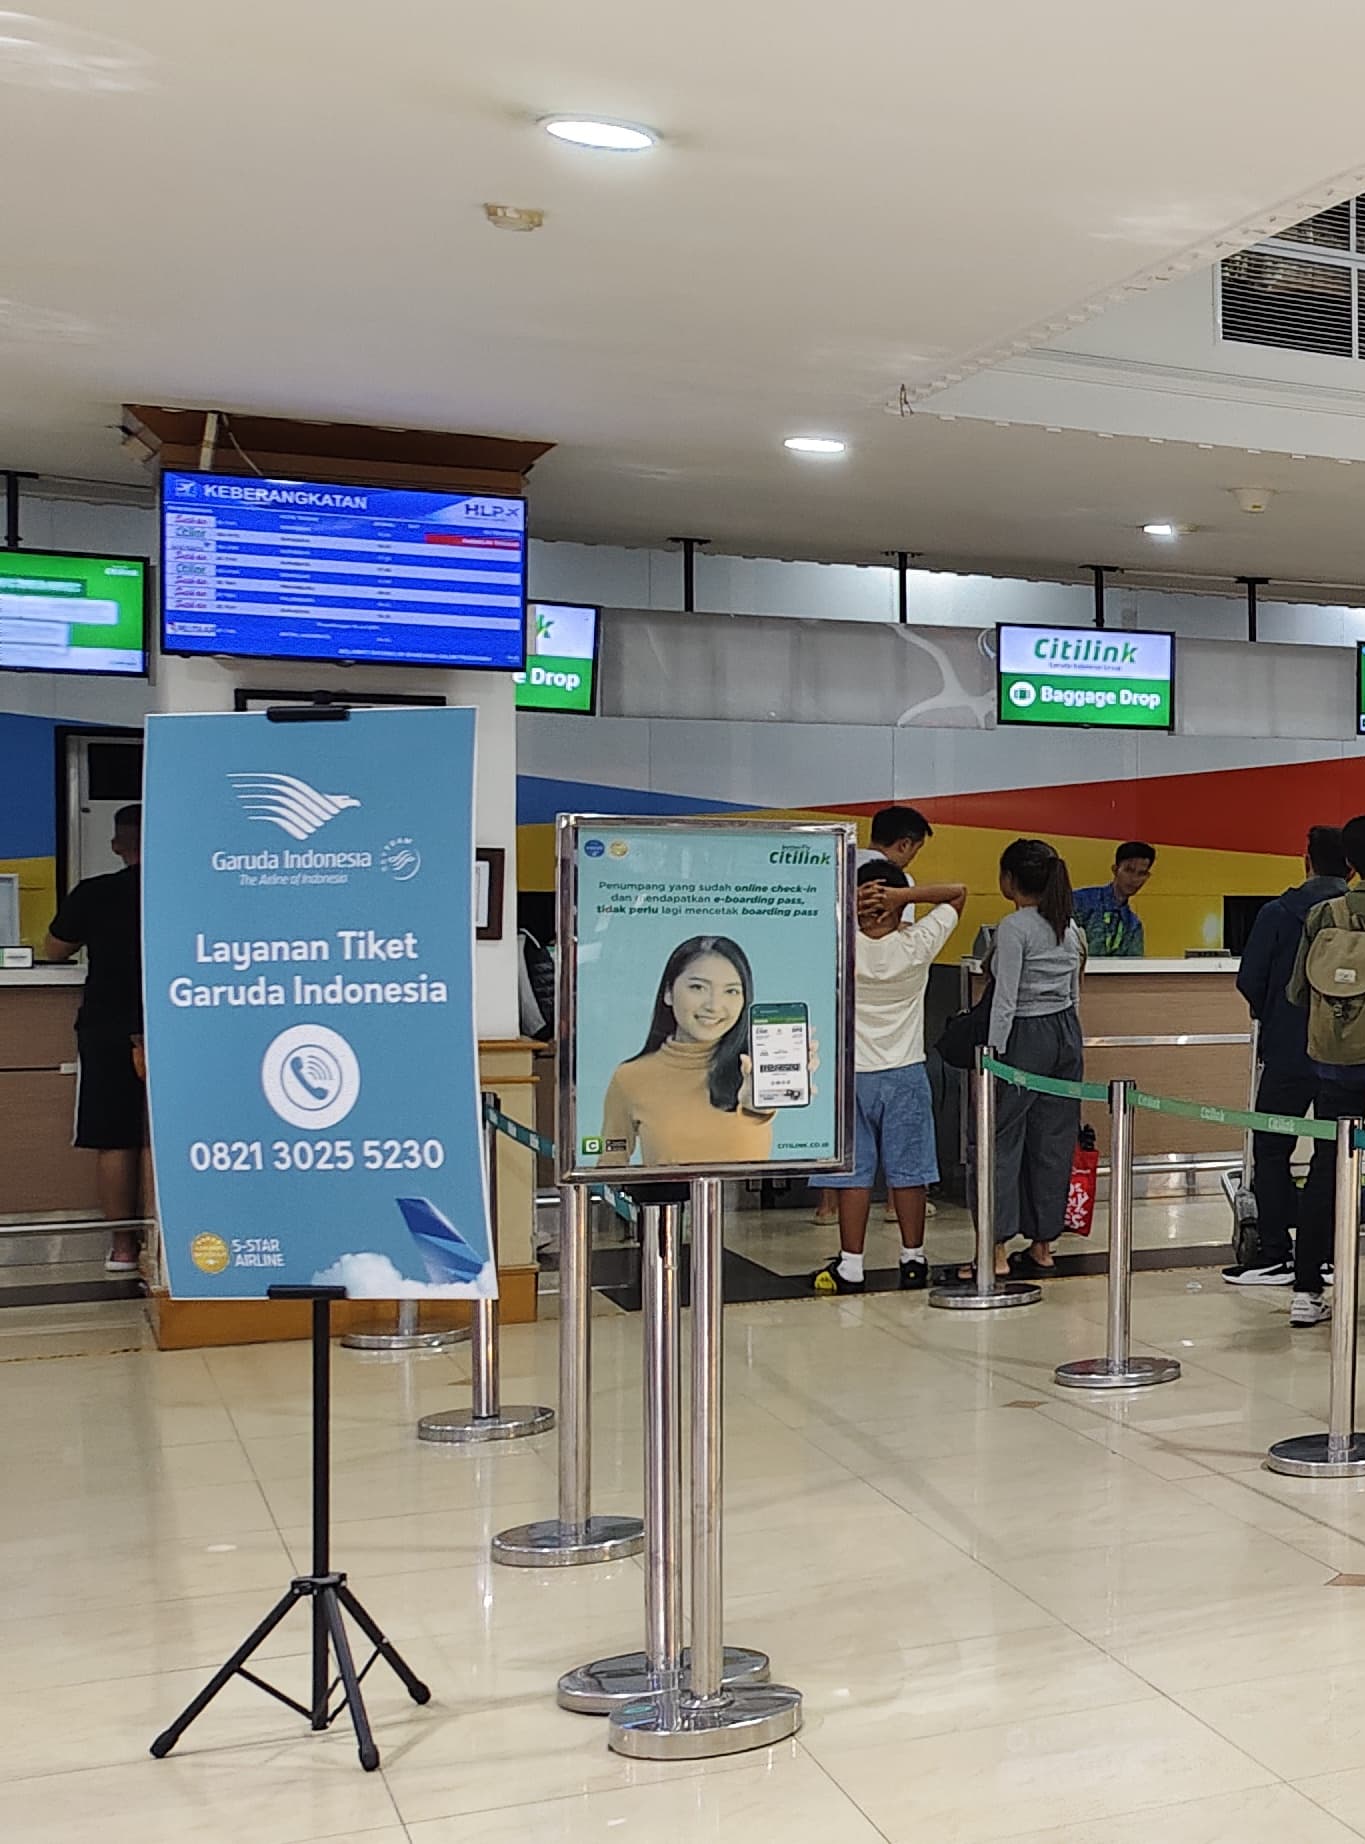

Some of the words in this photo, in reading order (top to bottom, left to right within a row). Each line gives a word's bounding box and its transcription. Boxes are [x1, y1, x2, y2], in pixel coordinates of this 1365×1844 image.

[204, 483, 368, 510] KEBERANGKATAN
[1034, 638, 1138, 664] Citilink
[530, 667, 581, 691] Drop
[1040, 685, 1117, 709] Baggage
[1119, 689, 1161, 710] Drop
[212, 850, 279, 871] Garuda
[284, 849, 372, 869] Indonesia
[769, 850, 831, 865] Citilink
[239, 874, 257, 886] The
[599, 881, 666, 892] Penumpang
[669, 883, 696, 892] yang
[700, 883, 732, 892] sudah
[734, 884, 769, 893] online
[771, 884, 817, 893] check-in
[611, 893, 633, 902] dan
[713, 895, 775, 905] e-boarding
[597, 904, 626, 914] tidak
[629, 905, 659, 915] perlu
[661, 905, 682, 915] lagi
[684, 906, 739, 916] mencetak
[741, 907, 791, 917] boarding
[793, 909, 819, 917] pass
[196, 933, 330, 971] Layanan
[337, 930, 418, 962] Tiket
[169, 976, 286, 1008] Garuda
[294, 974, 448, 1005] Indonesia
[190, 1140, 264, 1171] 0821
[273, 1140, 355, 1170] 3025
[363, 1139, 444, 1170] 5230
[231, 1238, 280, 1252] 5-STAR
[235, 1253, 286, 1267] AIRLINE
